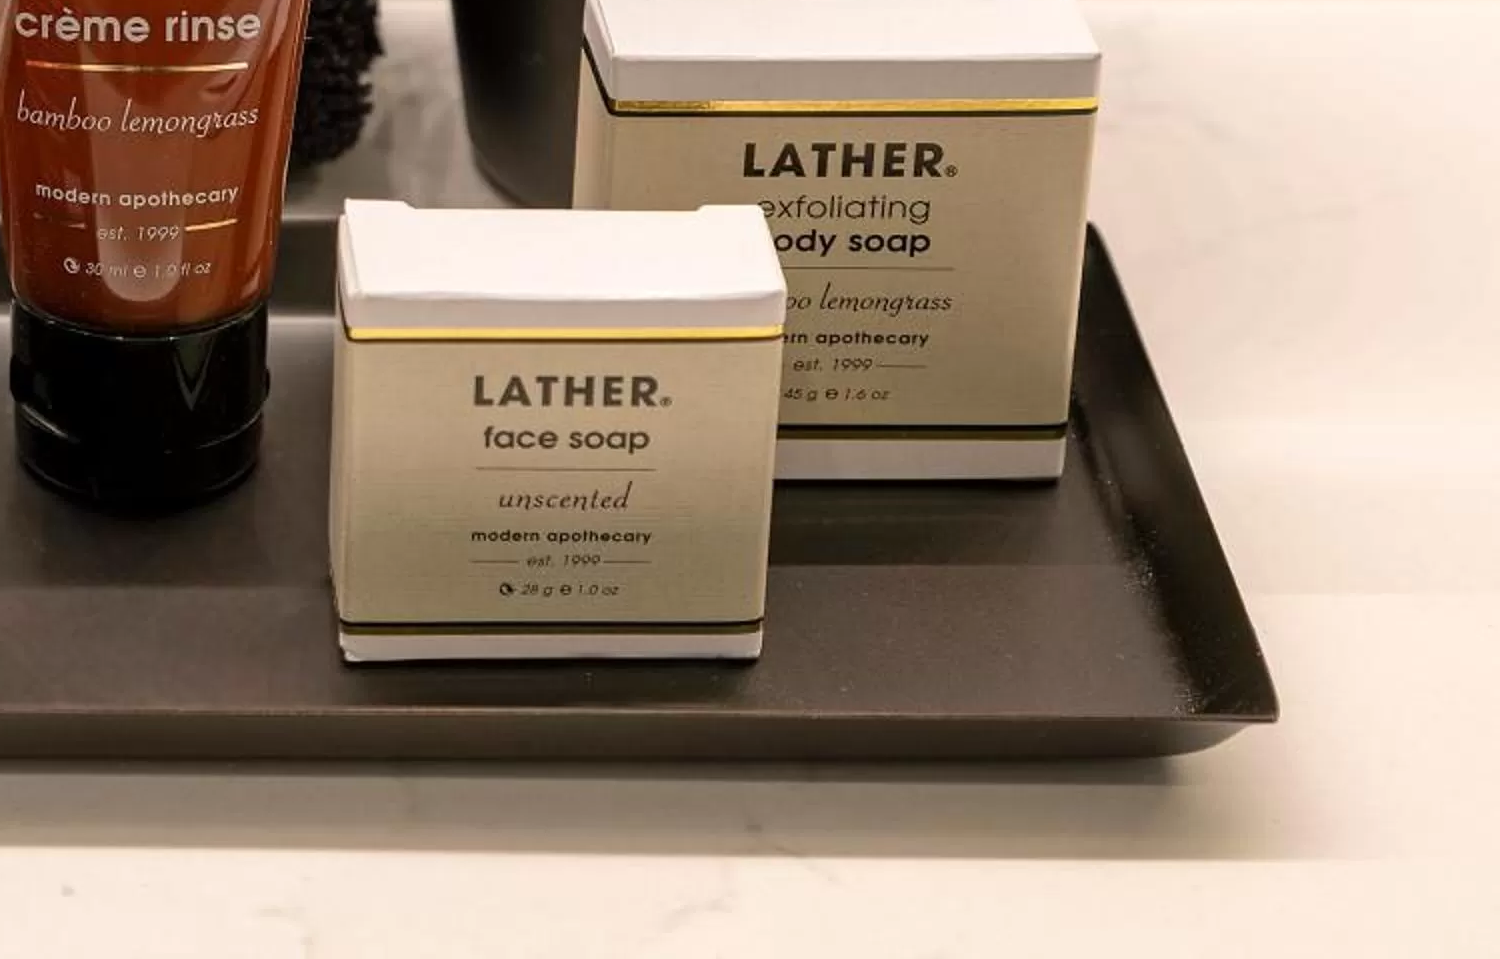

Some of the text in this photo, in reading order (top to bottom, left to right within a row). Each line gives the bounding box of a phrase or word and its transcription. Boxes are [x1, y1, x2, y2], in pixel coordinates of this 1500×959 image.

[14, 8, 261, 42] crème rinse
[17, 89, 259, 138] bamboo lemongrass
[35, 183, 238, 209] modern apothecary
[758, 195, 931, 225] exfoliating
[137, 225, 180, 241] 1999
[774, 228, 931, 257] ody soap
[819, 281, 952, 317] lemongrass
[815, 331, 929, 347] apothecary
[833, 358, 873, 372] 1999
[806, 390, 818, 402] g
[871, 390, 891, 401] oz
[484, 425, 650, 455] face soap
[499, 480, 633, 512] unscented
[471, 530, 651, 544] modern apothecary
[543, 586, 554, 597] g
